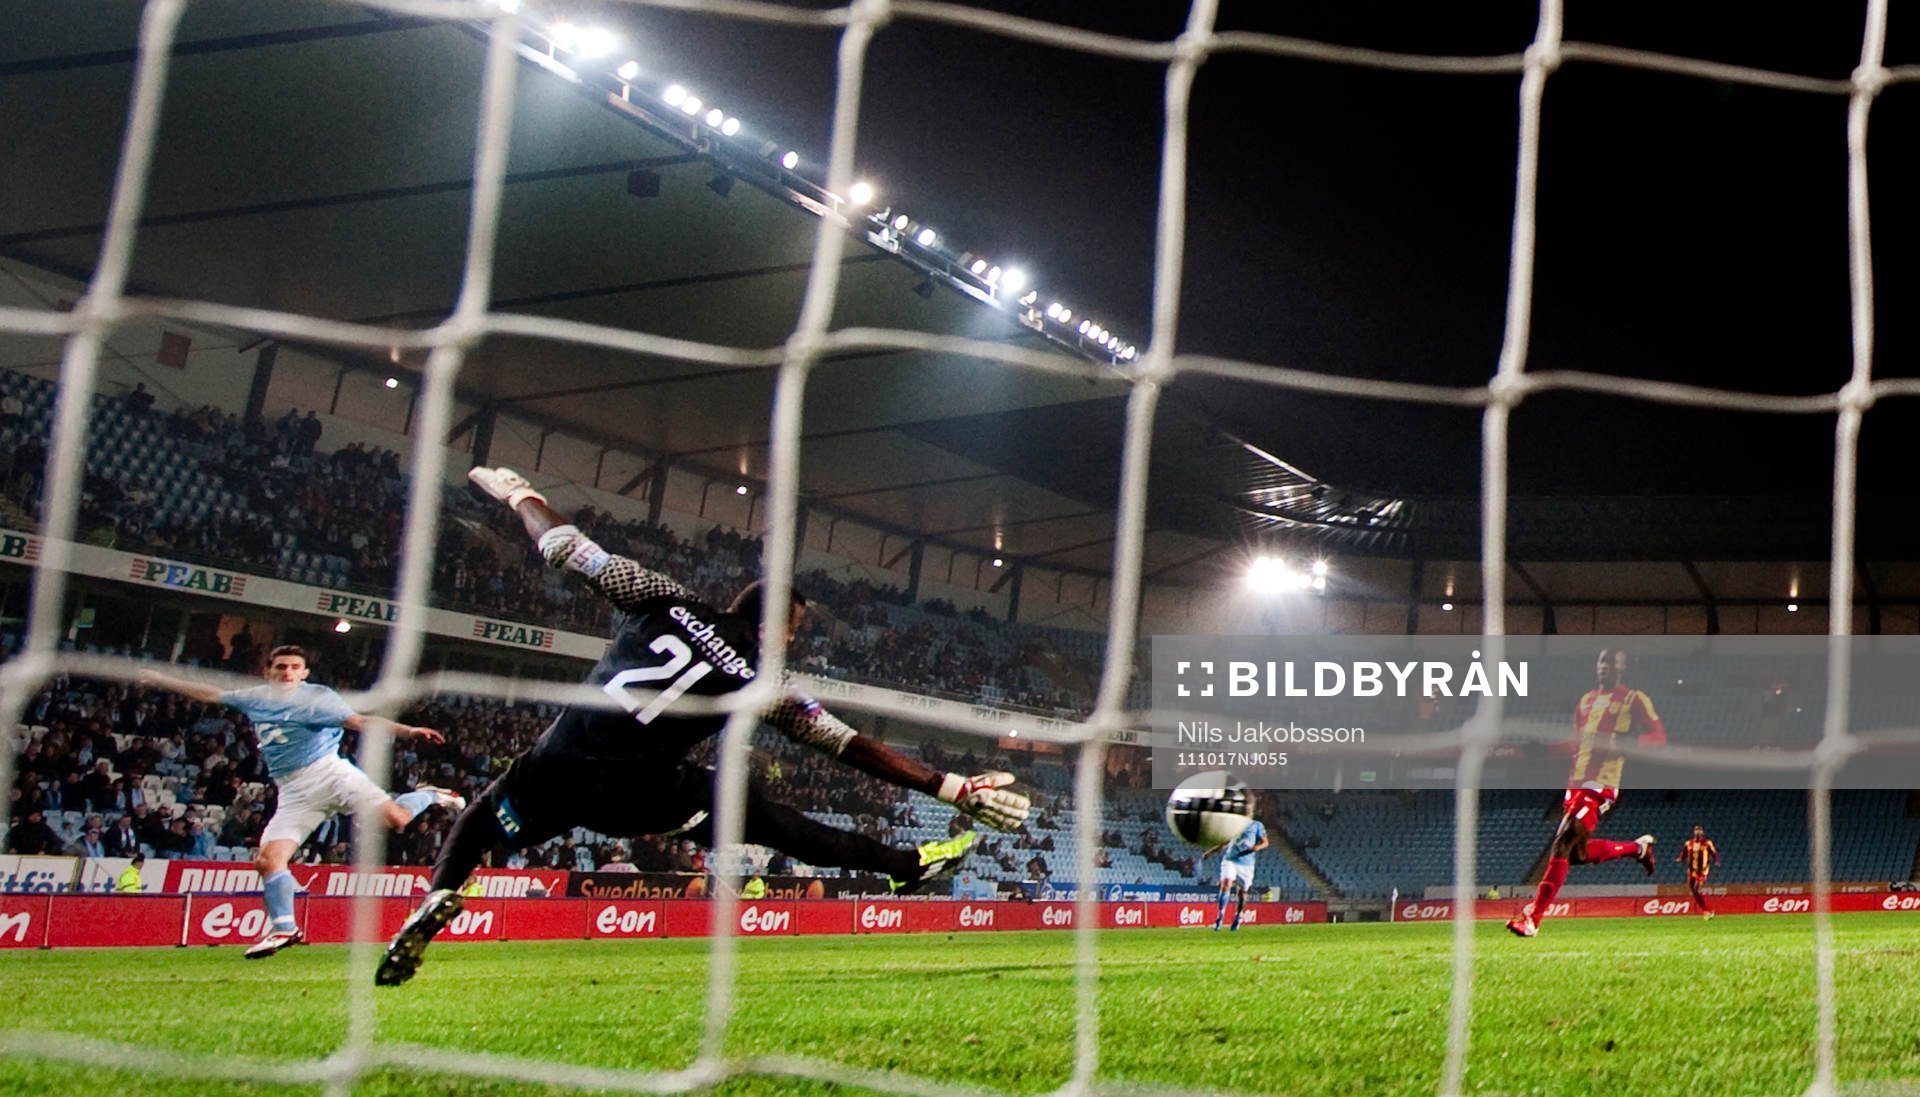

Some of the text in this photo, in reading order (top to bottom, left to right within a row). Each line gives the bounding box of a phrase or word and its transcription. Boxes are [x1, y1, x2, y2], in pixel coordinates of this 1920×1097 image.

[144, 559, 235, 595] PEAB
[481, 621, 545, 647] PEAB
[669, 606, 756, 679] exchange
[603, 634, 713, 725] 21
